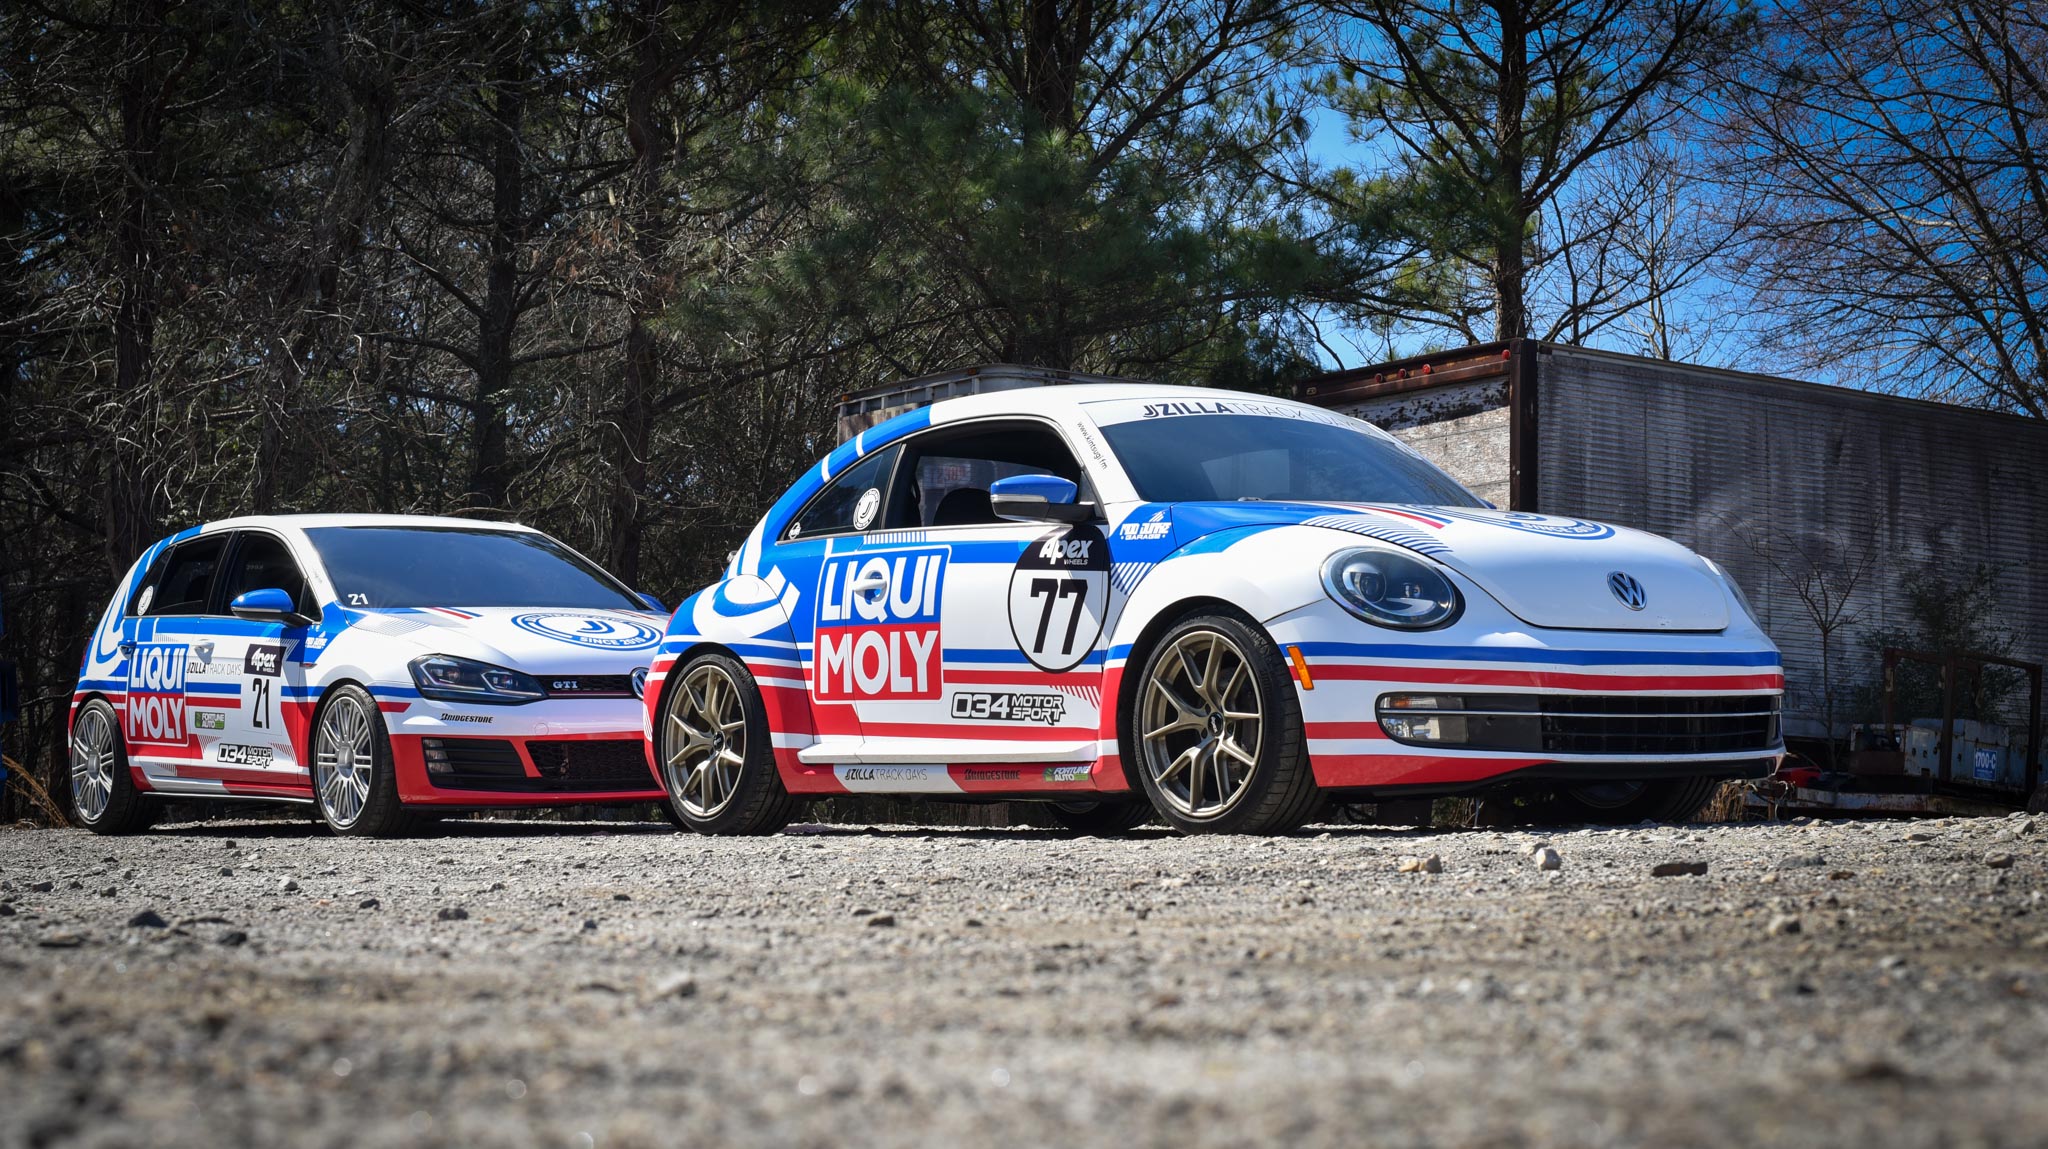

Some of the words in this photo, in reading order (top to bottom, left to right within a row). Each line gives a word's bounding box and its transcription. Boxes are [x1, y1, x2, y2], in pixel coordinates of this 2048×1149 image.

[1077, 421, 1108, 470] www.kintsugi.fm
[1039, 535, 1093, 565] Apex
[821, 555, 942, 623] LIQUI
[347, 593, 369, 605] 21
[1030, 578, 1088, 655] 77
[580, 636, 619, 646] SINCE
[130, 647, 186, 691] LIQUI
[819, 630, 939, 695] MOLY
[206, 663, 226, 675] TRACK
[227, 664, 242, 676] DAYS
[553, 680, 578, 689] GTI
[252, 678, 270, 729] 21
[953, 693, 1010, 719] 034
[1011, 695, 1063, 709] MOTOR
[129, 696, 183, 739] MOLY
[440, 712, 494, 724] BRIDGESTONE
[1011, 708, 1065, 724] SPORT
[201, 720, 216, 728] AUTO
[246, 747, 272, 758] MOTOR
[246, 755, 273, 769] SPORT
[875, 769, 904, 780] TRACK
[905, 769, 928, 780] DAYS
[964, 768, 1020, 780] BRIDGESTONE
[1054, 766, 1091, 775] FORTUNE
[1054, 773, 1075, 782] AUTO
